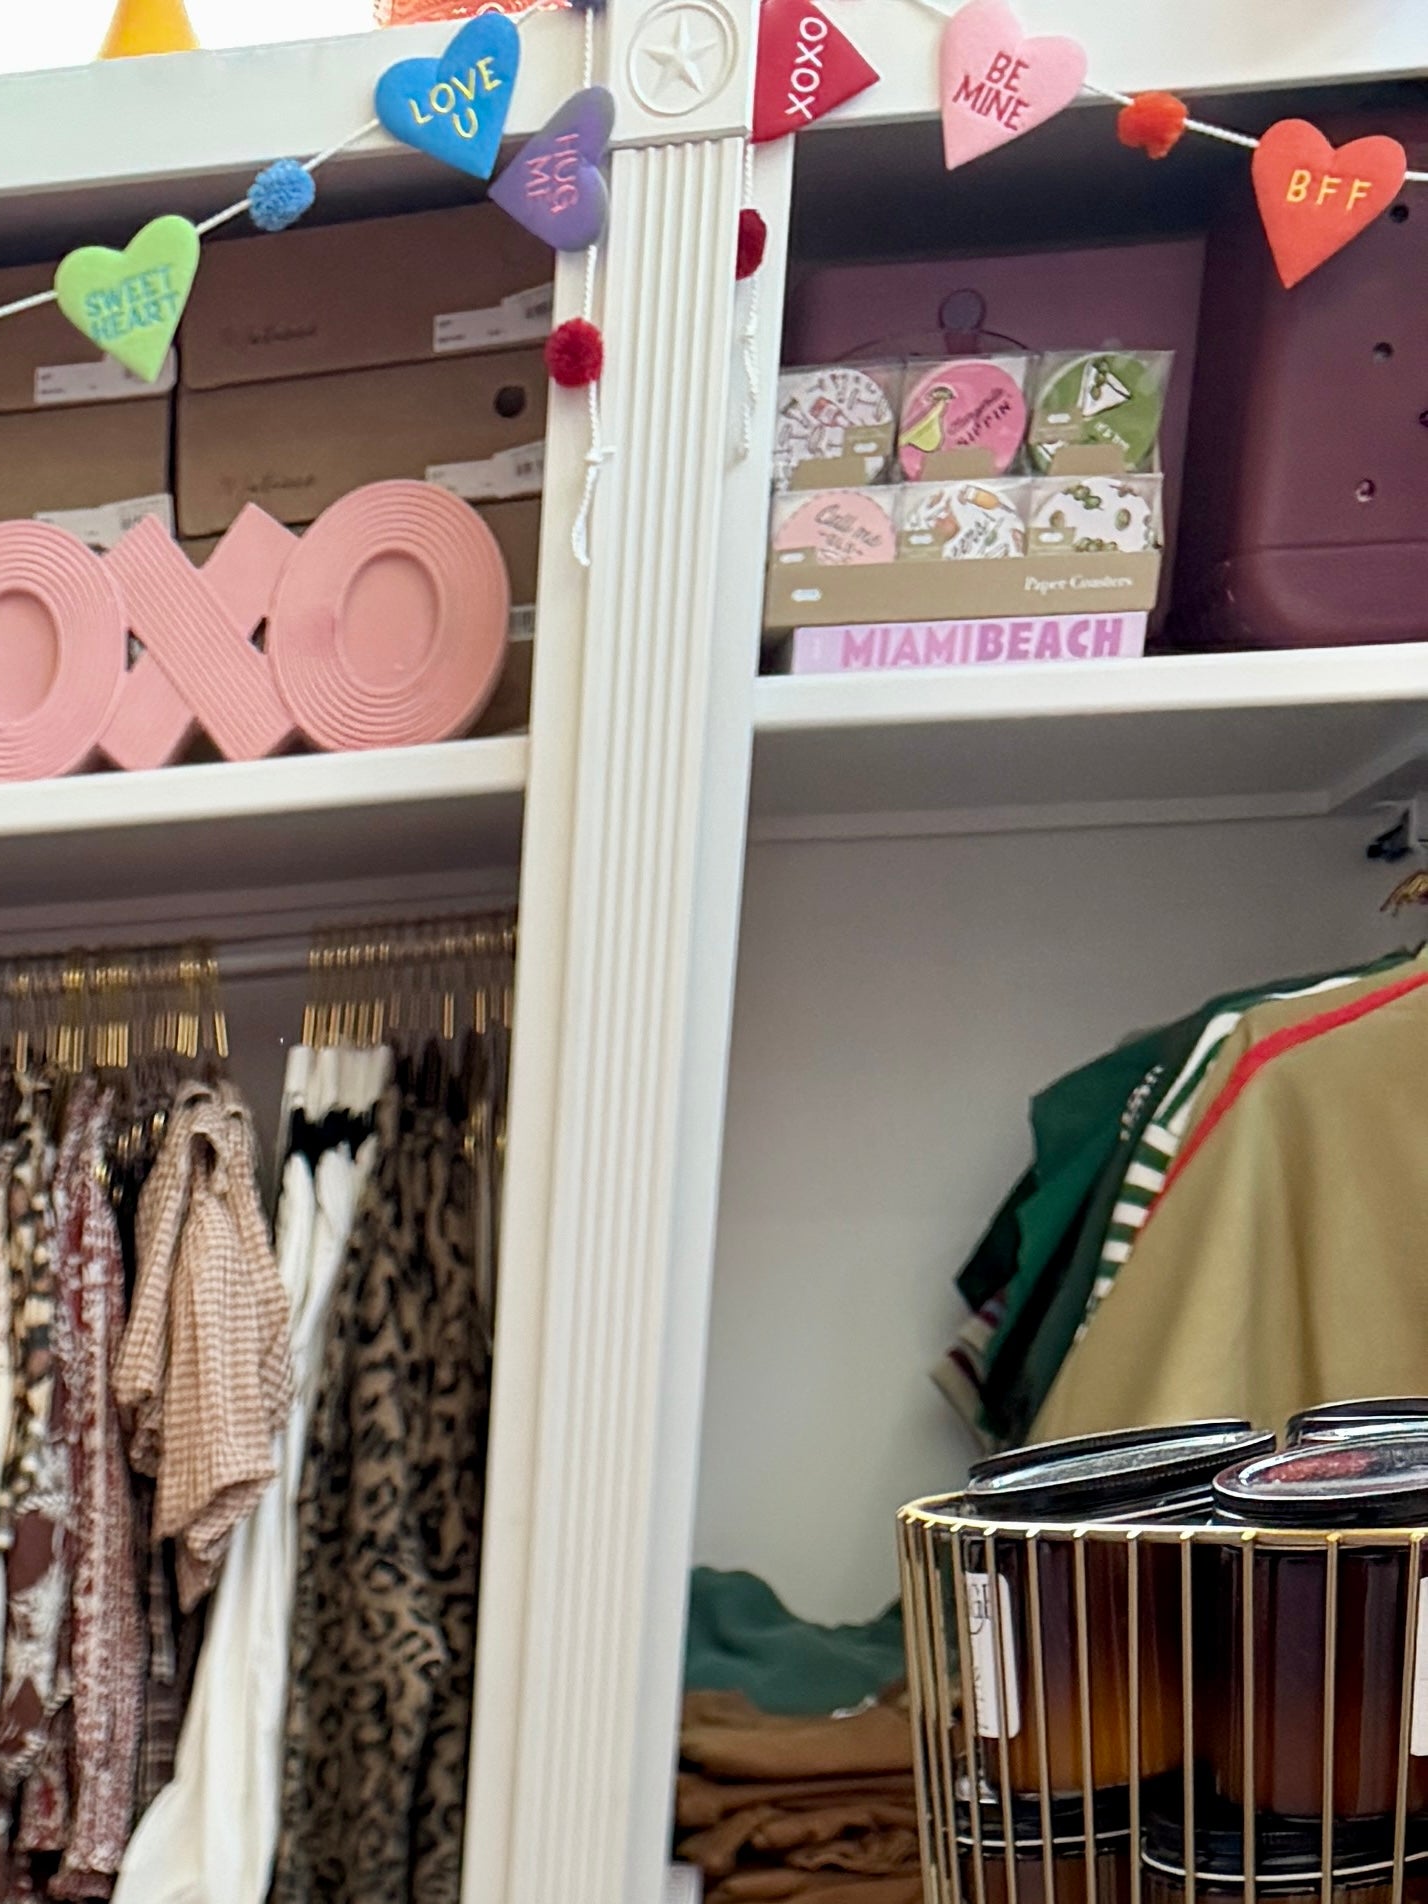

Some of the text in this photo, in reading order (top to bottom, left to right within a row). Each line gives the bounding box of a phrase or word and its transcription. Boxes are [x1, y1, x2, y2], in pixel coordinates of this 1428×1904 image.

[410, 56, 503, 125] LOVE
[785, 16, 828, 119] XOXO
[987, 50, 1029, 92] BE
[452, 107, 478, 139] U
[952, 75, 1029, 131] MINE
[551, 133, 580, 213] HUG
[1285, 168, 1373, 211] BFF
[84, 265, 176, 320] SWEET
[90, 294, 182, 343] HEART
[1024, 573, 1134, 596] Paper Coasters
